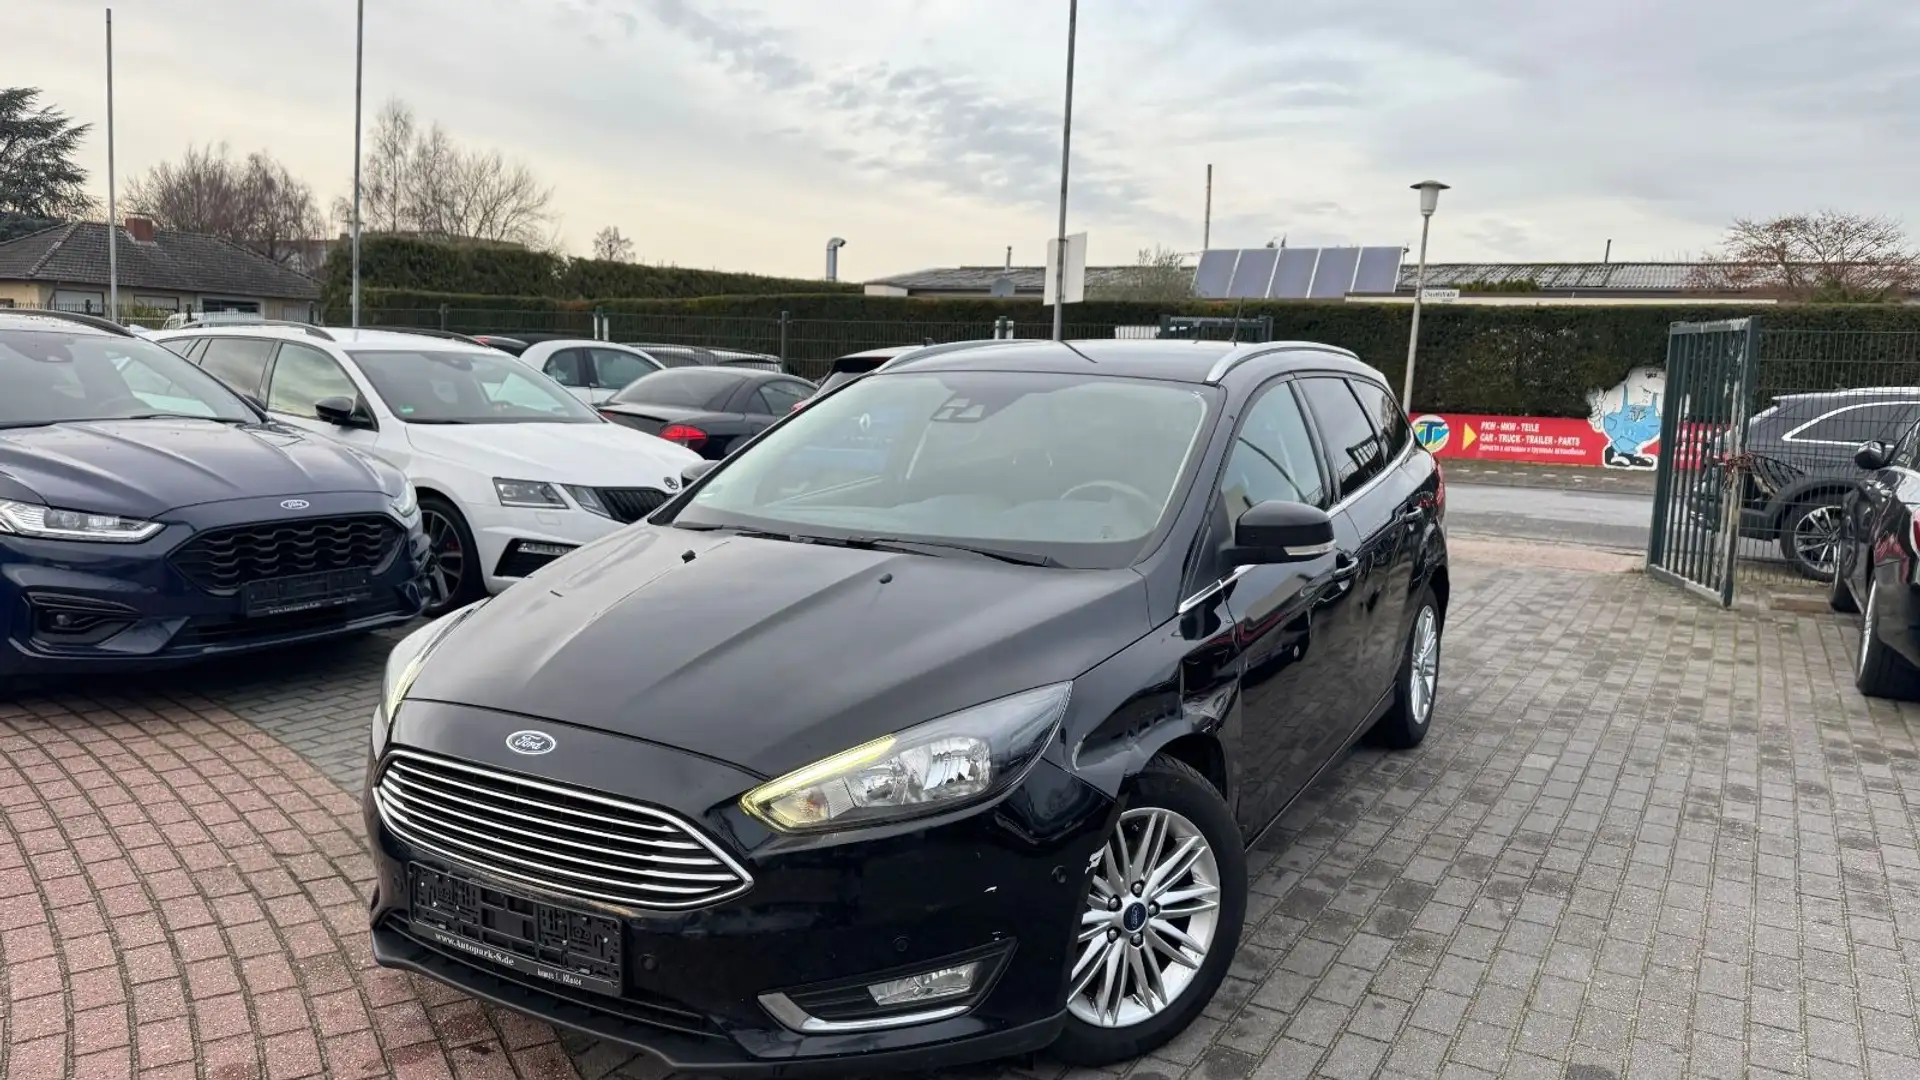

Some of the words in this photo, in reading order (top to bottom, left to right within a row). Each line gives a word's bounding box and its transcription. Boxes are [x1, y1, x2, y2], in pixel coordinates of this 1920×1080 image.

[1480, 420, 1497, 431] PKW
[1520, 422, 1540, 433] TEILE
[1479, 433, 1495, 442] CAR
[1498, 433, 1521, 444] TRUCK
[1525, 434, 1553, 445] TRAILER
[1557, 436, 1581, 447] PARTS
[434, 932, 515, 966] www.Autopark-S.de
